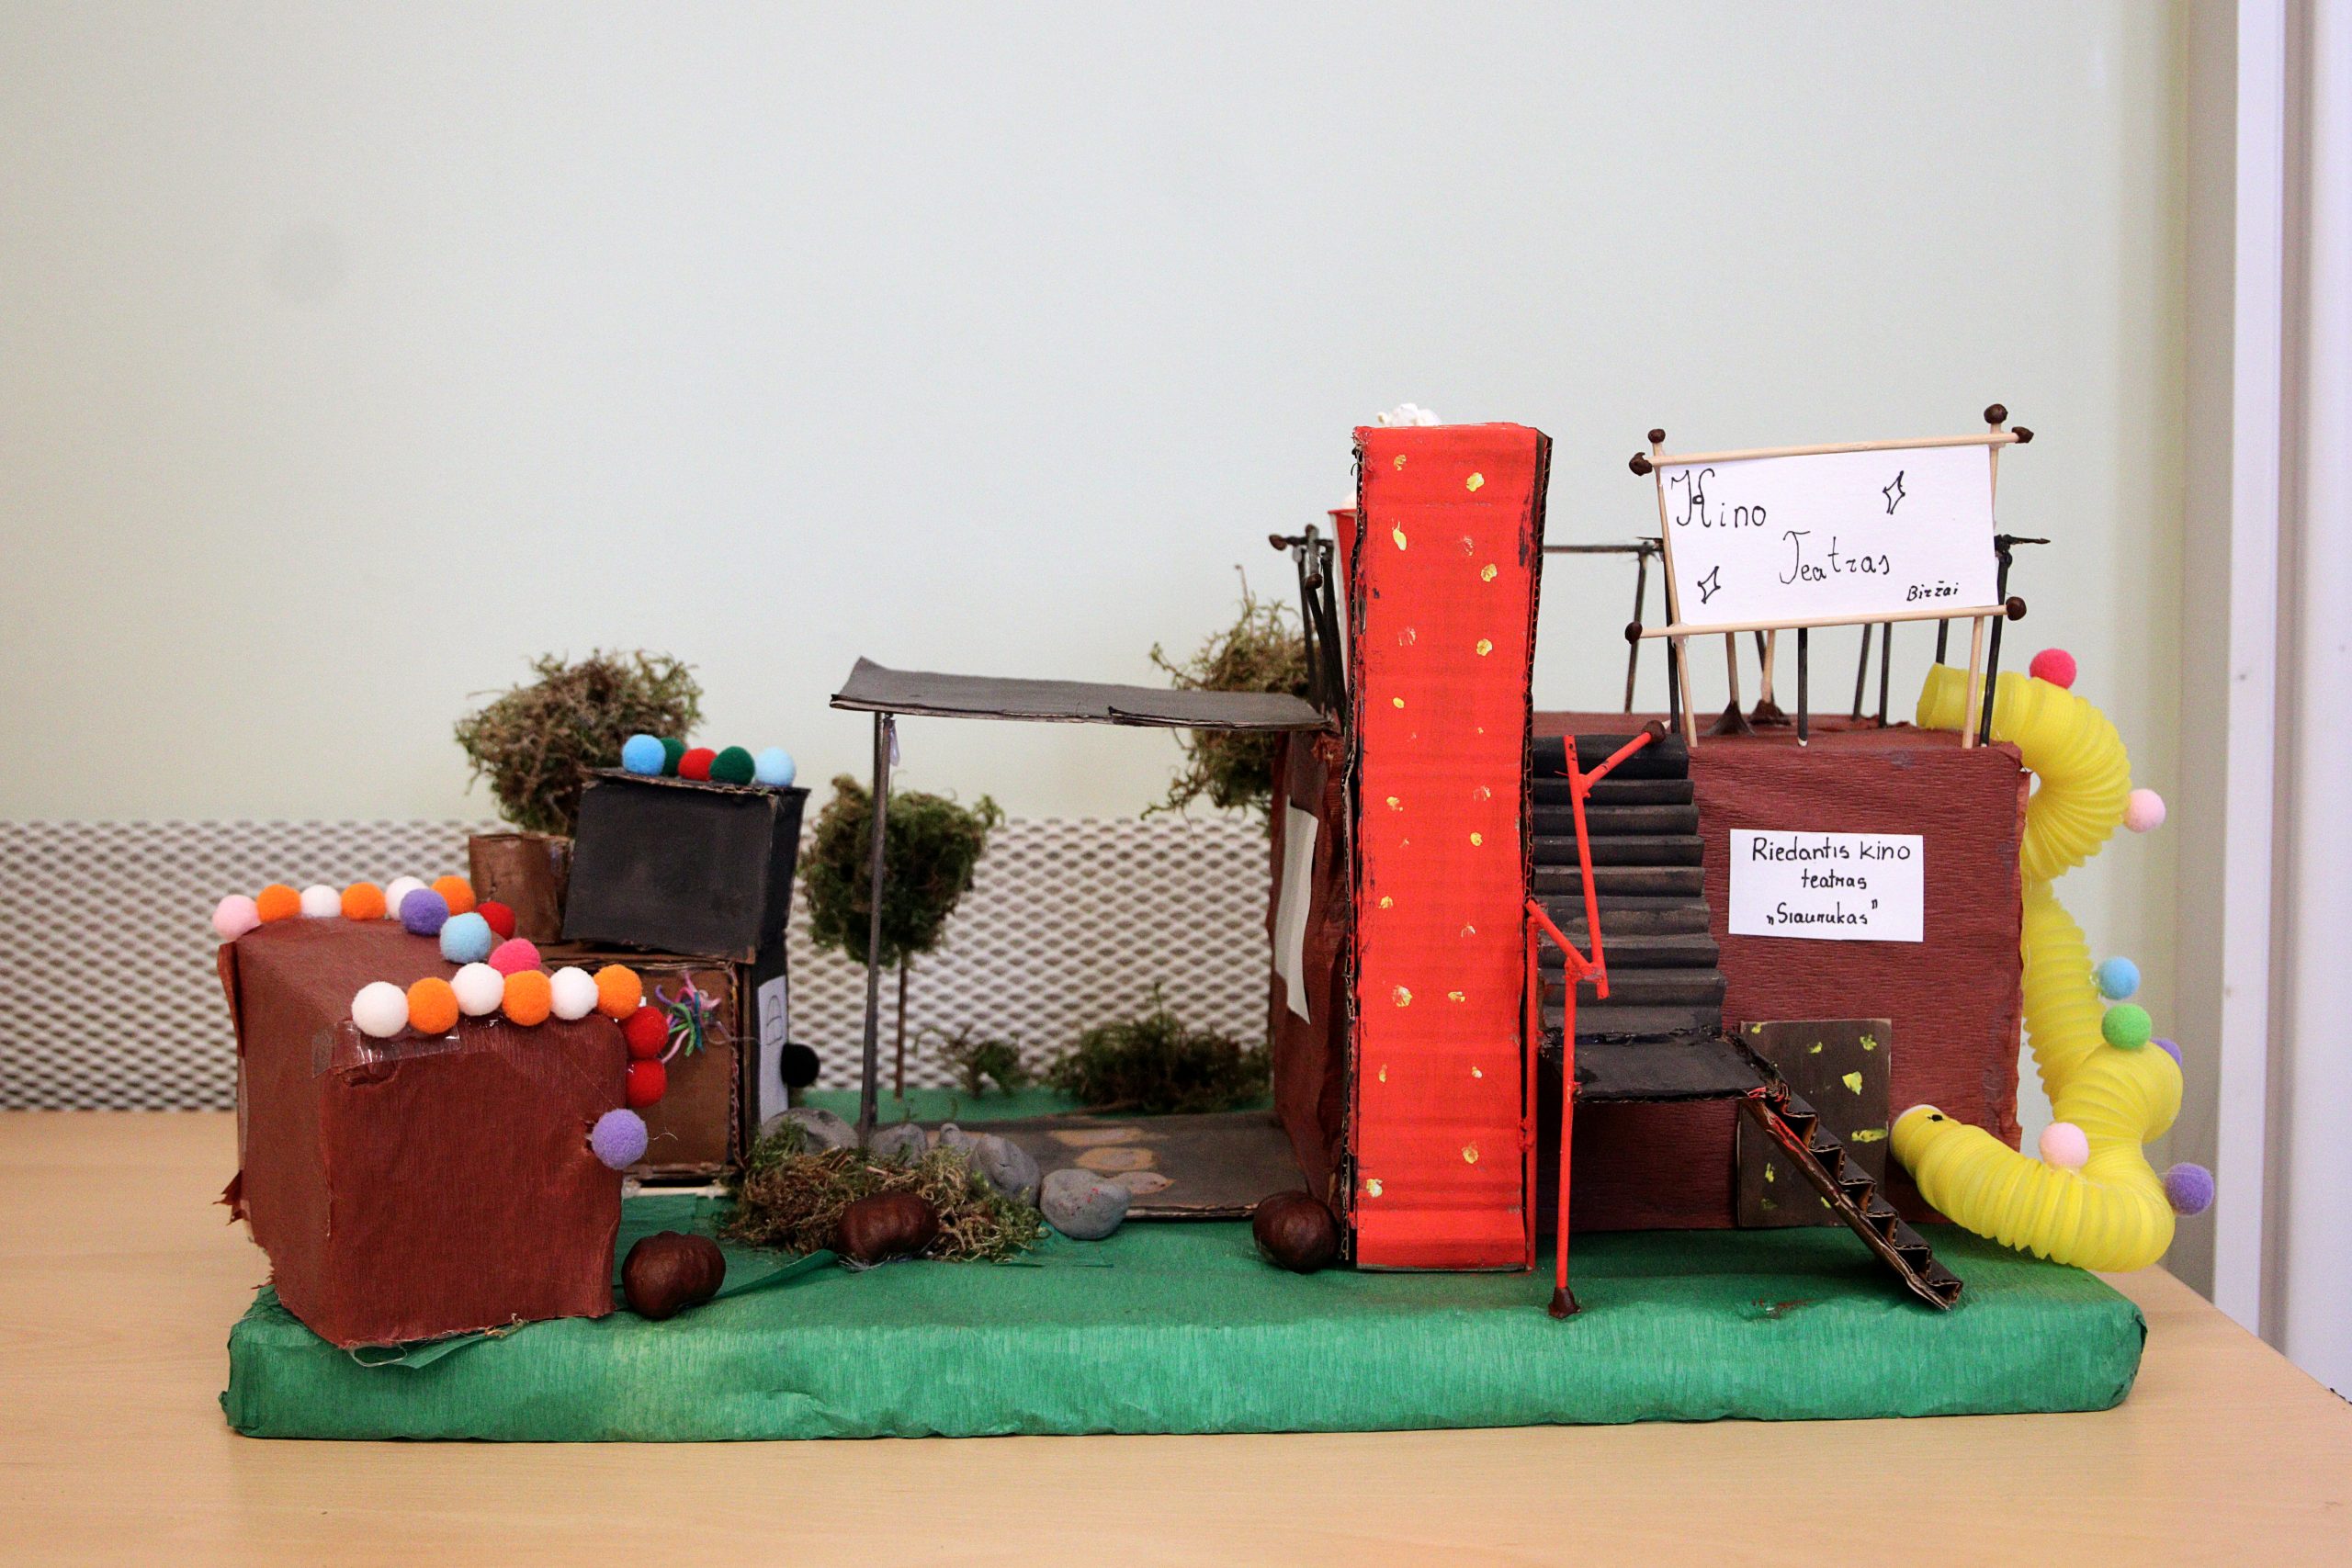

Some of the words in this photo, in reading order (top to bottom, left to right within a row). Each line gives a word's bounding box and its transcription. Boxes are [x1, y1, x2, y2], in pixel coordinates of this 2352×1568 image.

[1670, 468, 1767, 528] Kino
[1779, 530, 1891, 585] Teatras
[1751, 835, 1850, 862] Riedantis
[1859, 840, 1911, 861] kino
[1801, 868, 1868, 890] teatras
